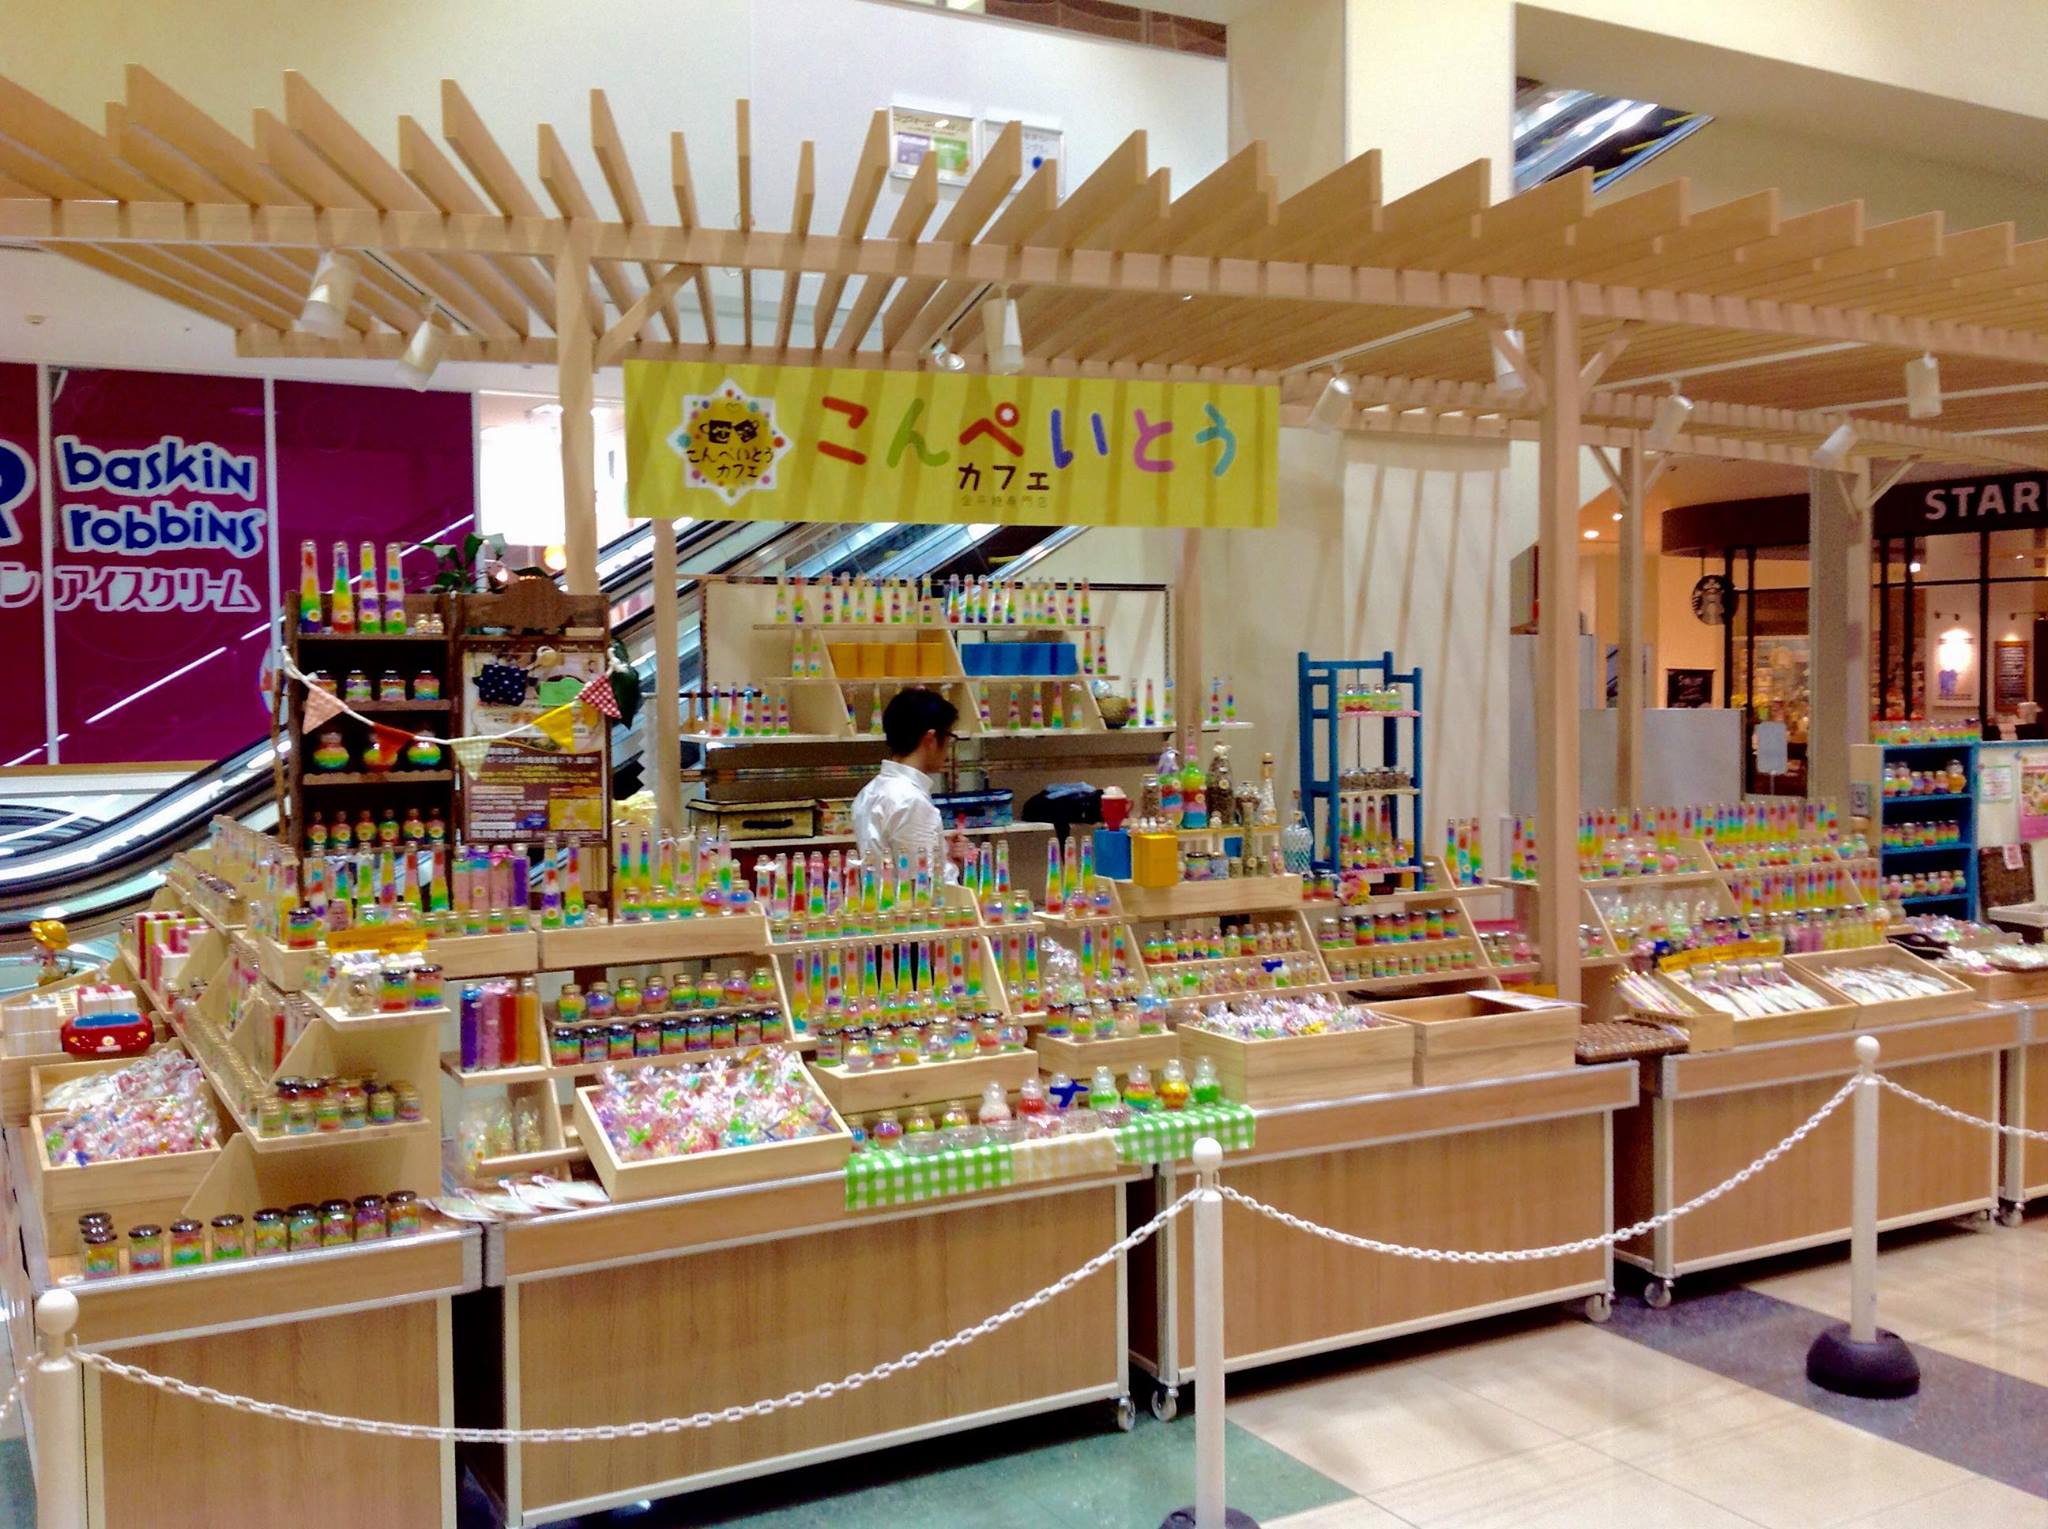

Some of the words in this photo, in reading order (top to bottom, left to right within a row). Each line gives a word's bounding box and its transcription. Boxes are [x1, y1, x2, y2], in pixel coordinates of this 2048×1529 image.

[816, 397, 1237, 477] こんぺいとう
[61, 440, 253, 496] baskin
[716, 463, 759, 479] カフェ
[957, 461, 1051, 492] カフェ
[1924, 480, 2048, 521] STAR
[69, 504, 259, 554] robbins
[54, 568, 259, 610] アイスクリーム
